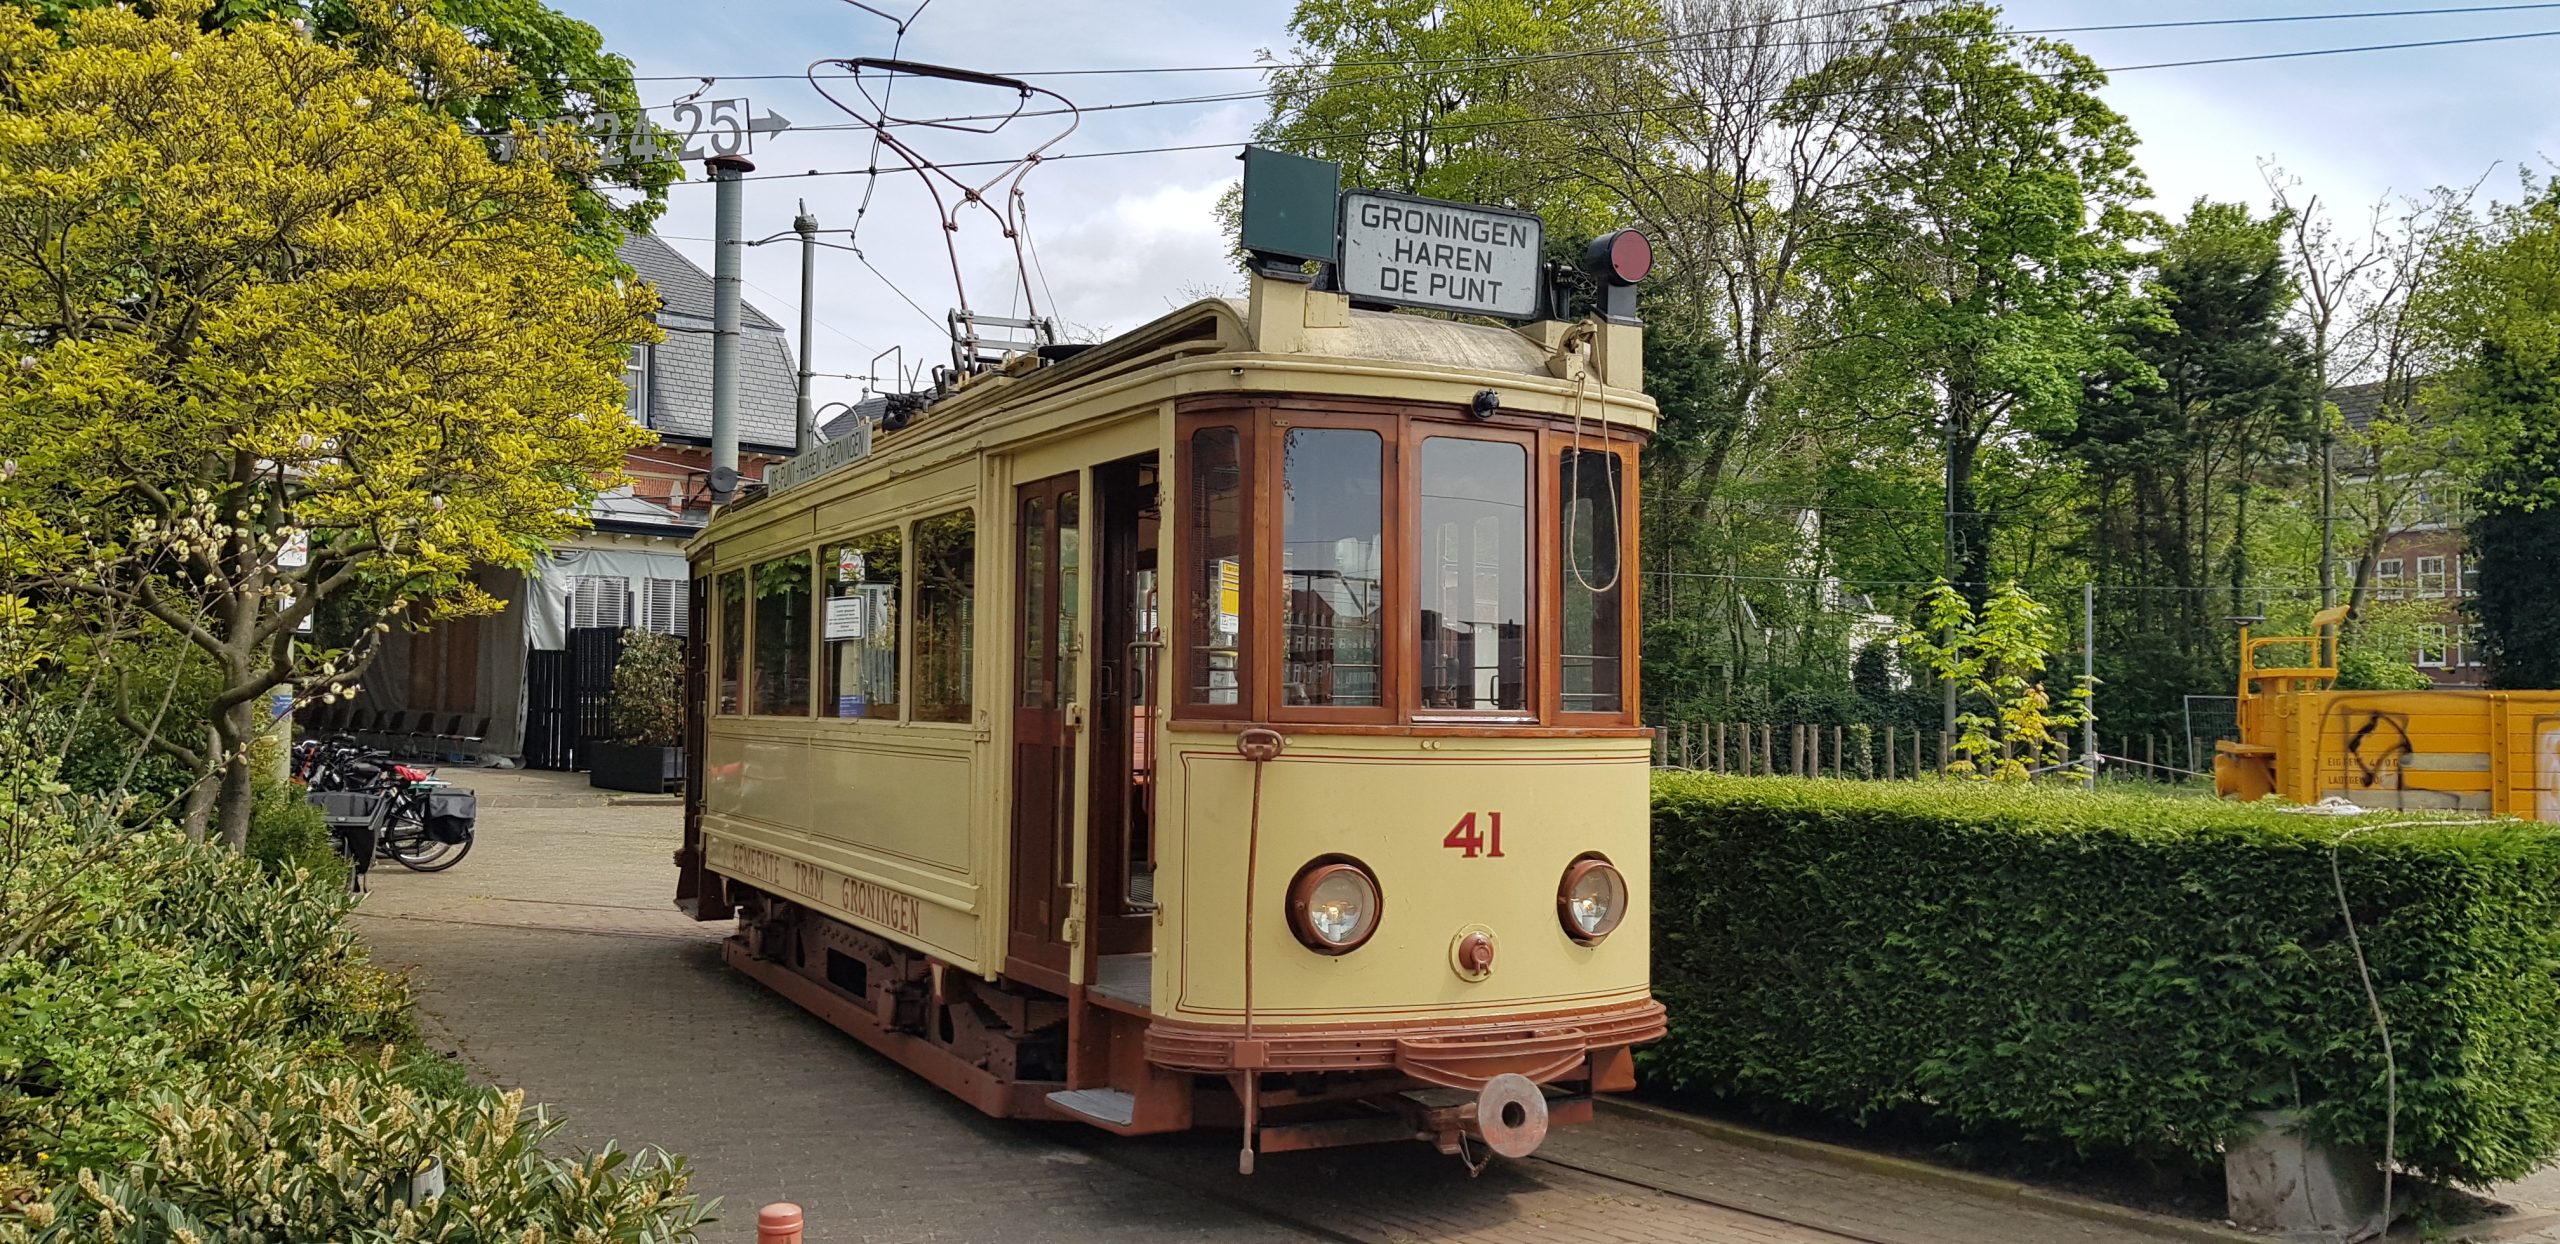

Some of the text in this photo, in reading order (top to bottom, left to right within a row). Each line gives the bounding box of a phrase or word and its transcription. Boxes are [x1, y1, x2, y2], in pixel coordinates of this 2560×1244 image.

[1361, 204, 1527, 249] GRONINGEN
[1394, 238, 1492, 274] HAREN
[1380, 267, 1503, 305] DE PUNT
[826, 429, 865, 469] GRONINGEN
[1443, 811, 1505, 858] 41
[733, 843, 919, 936] GEMEENTE TRAM GRONINGEN
